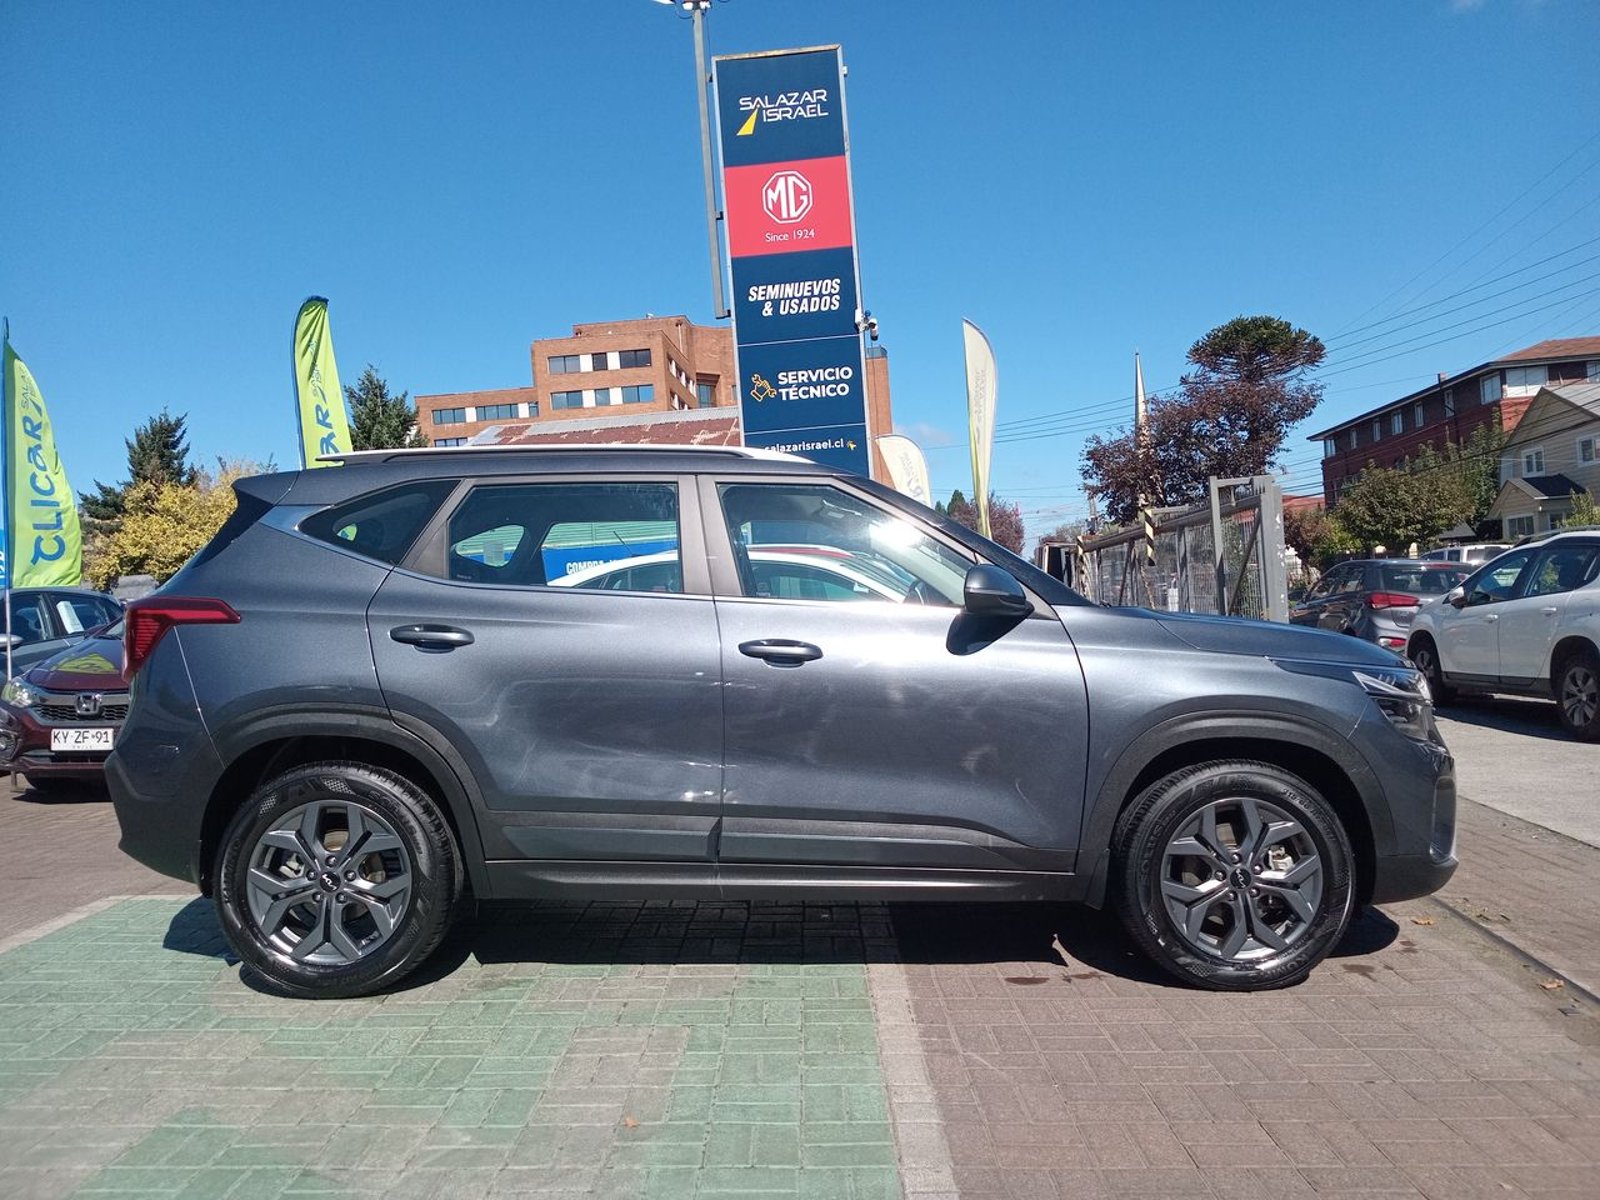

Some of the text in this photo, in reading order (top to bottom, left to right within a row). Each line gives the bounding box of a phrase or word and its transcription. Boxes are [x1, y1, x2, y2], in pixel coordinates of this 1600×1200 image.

[738, 89, 828, 111] SALAZAR
[762, 103, 829, 122] ISRAEL
[767, 176, 809, 219] MG
[765, 228, 815, 242] Since 1924
[748, 278, 841, 302] SEMINUEVOS
[762, 294, 841, 317] & USADOS
[777, 365, 853, 385] SERVICIO
[779, 383, 850, 401] TÉCNICO
